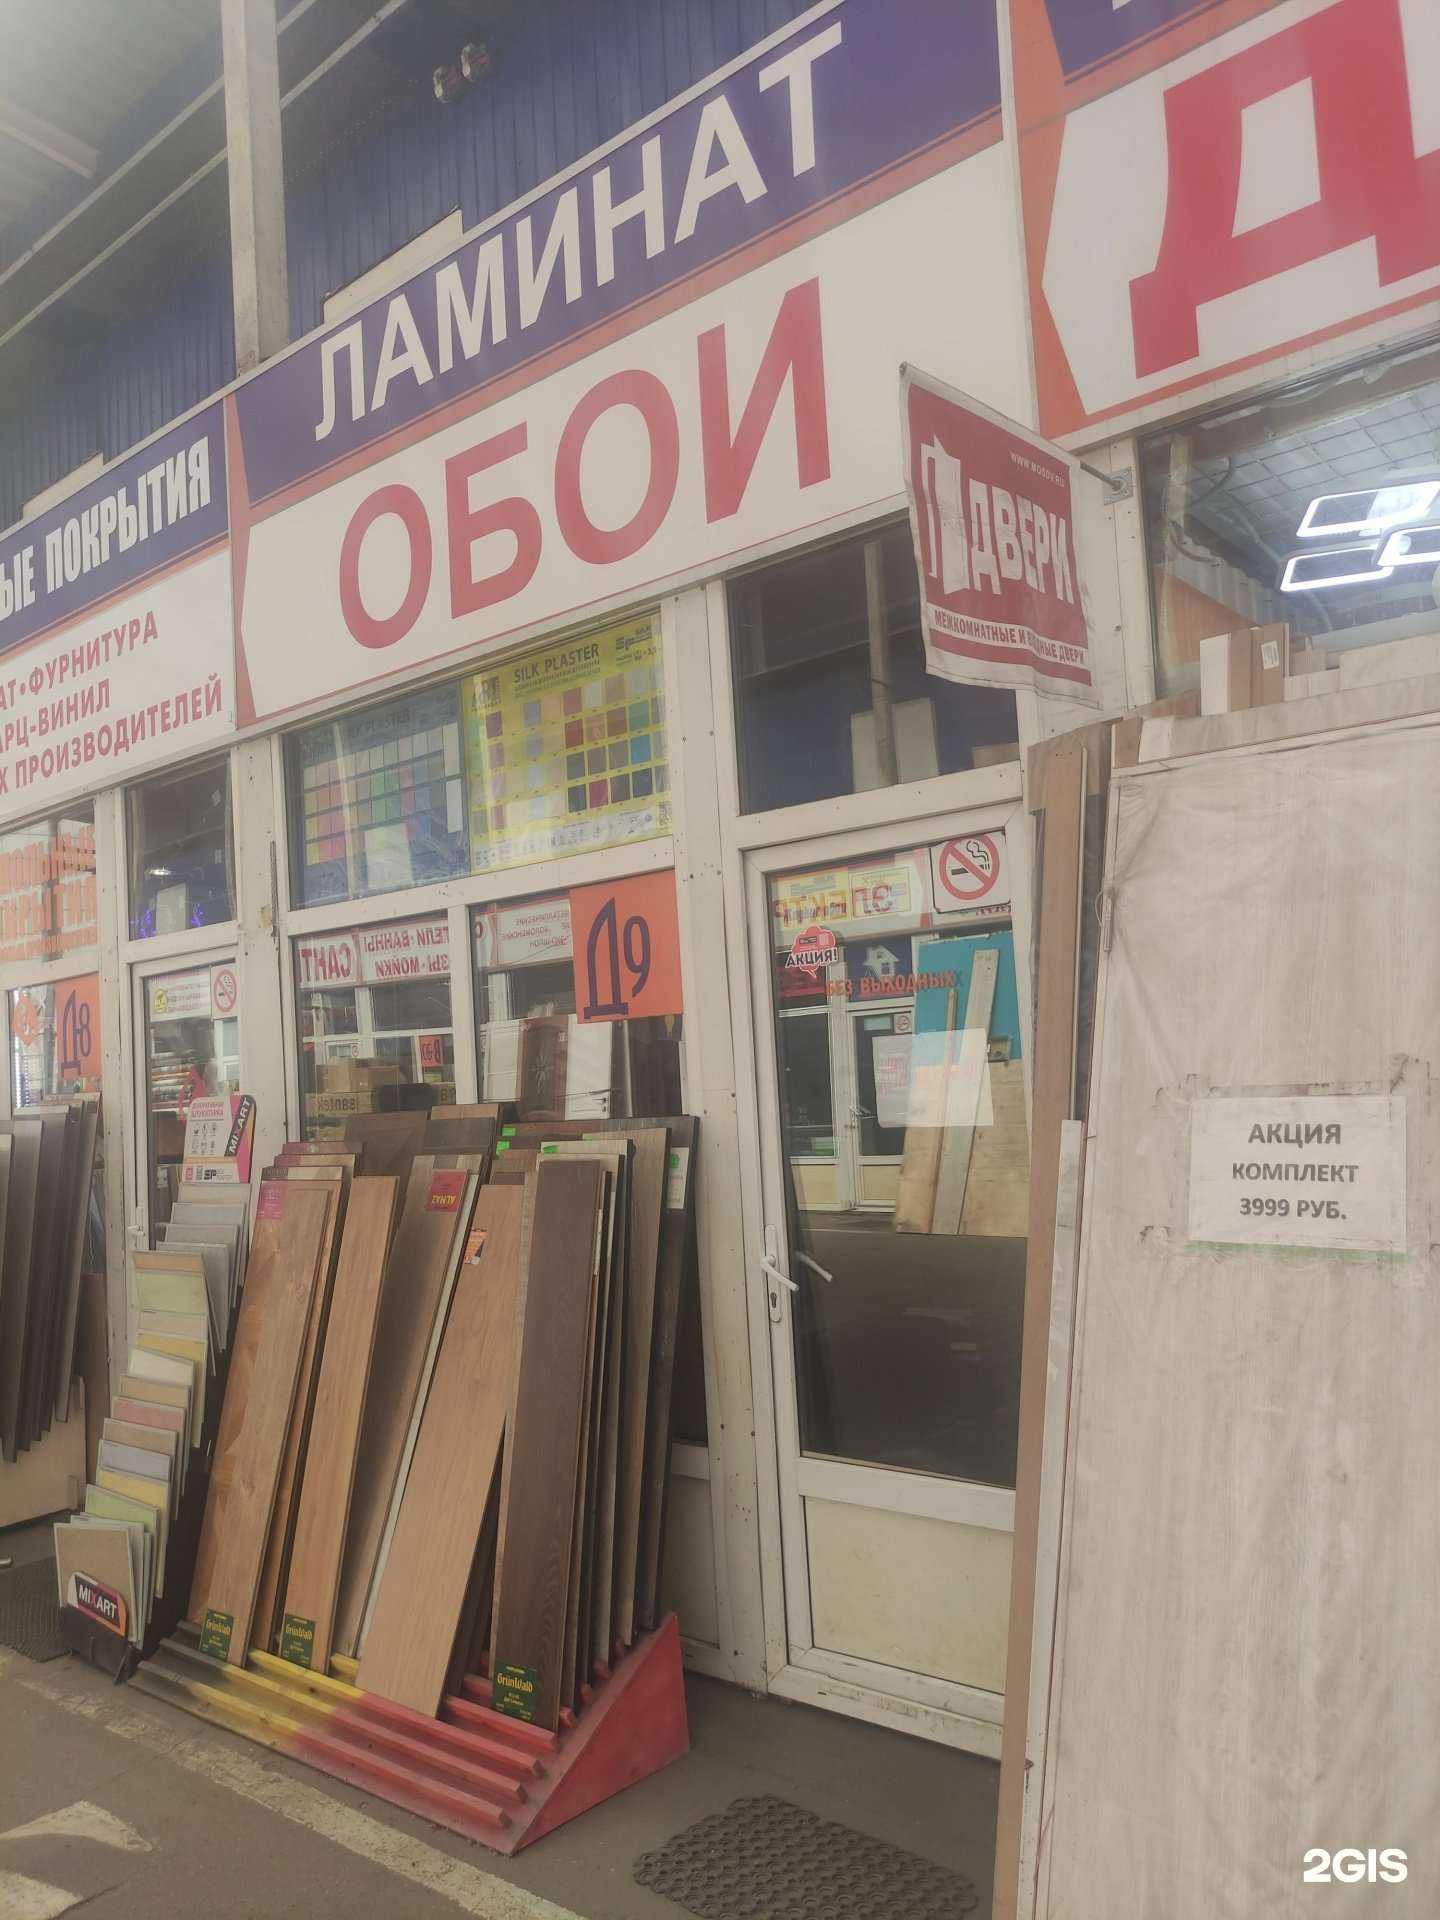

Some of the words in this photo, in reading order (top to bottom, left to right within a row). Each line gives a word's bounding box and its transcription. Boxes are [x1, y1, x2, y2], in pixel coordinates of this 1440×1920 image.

[315, 21, 842, 441] ЛАМИНАТ
[338, 275, 831, 649] ОБОИ
[46, 436, 211, 594] ПОКРЫТИЯ
[969, 478, 1074, 605] ДВЕРИ
[29, 610, 158, 695] ФУРНИТУРА
[934, 609, 1017, 645] МЕЖКОМНАТНЫЕ
[1018, 629, 1026, 645] И
[514, 662, 540, 681] SILK
[544, 643, 600, 673] PLASTER
[0, 678, 110, 753] РЦ-ВИНИЛ
[15, 673, 222, 789] ПРОИЗВОДИТЕЛЕЙ
[583, 896, 651, 1020] Д9
[785, 947, 837, 967] АКЦИЯ!
[860, 970, 956, 994] ВЫХОДНЫХ
[1247, 1123, 1341, 1148] АКЦИЯ
[1232, 1162, 1359, 1183] КОМПЛЕКТ
[1239, 1198, 1290, 1217] 3999
[1297, 1200, 1347, 1220] РУБ.
[79, 1584, 117, 1619] MIXART
